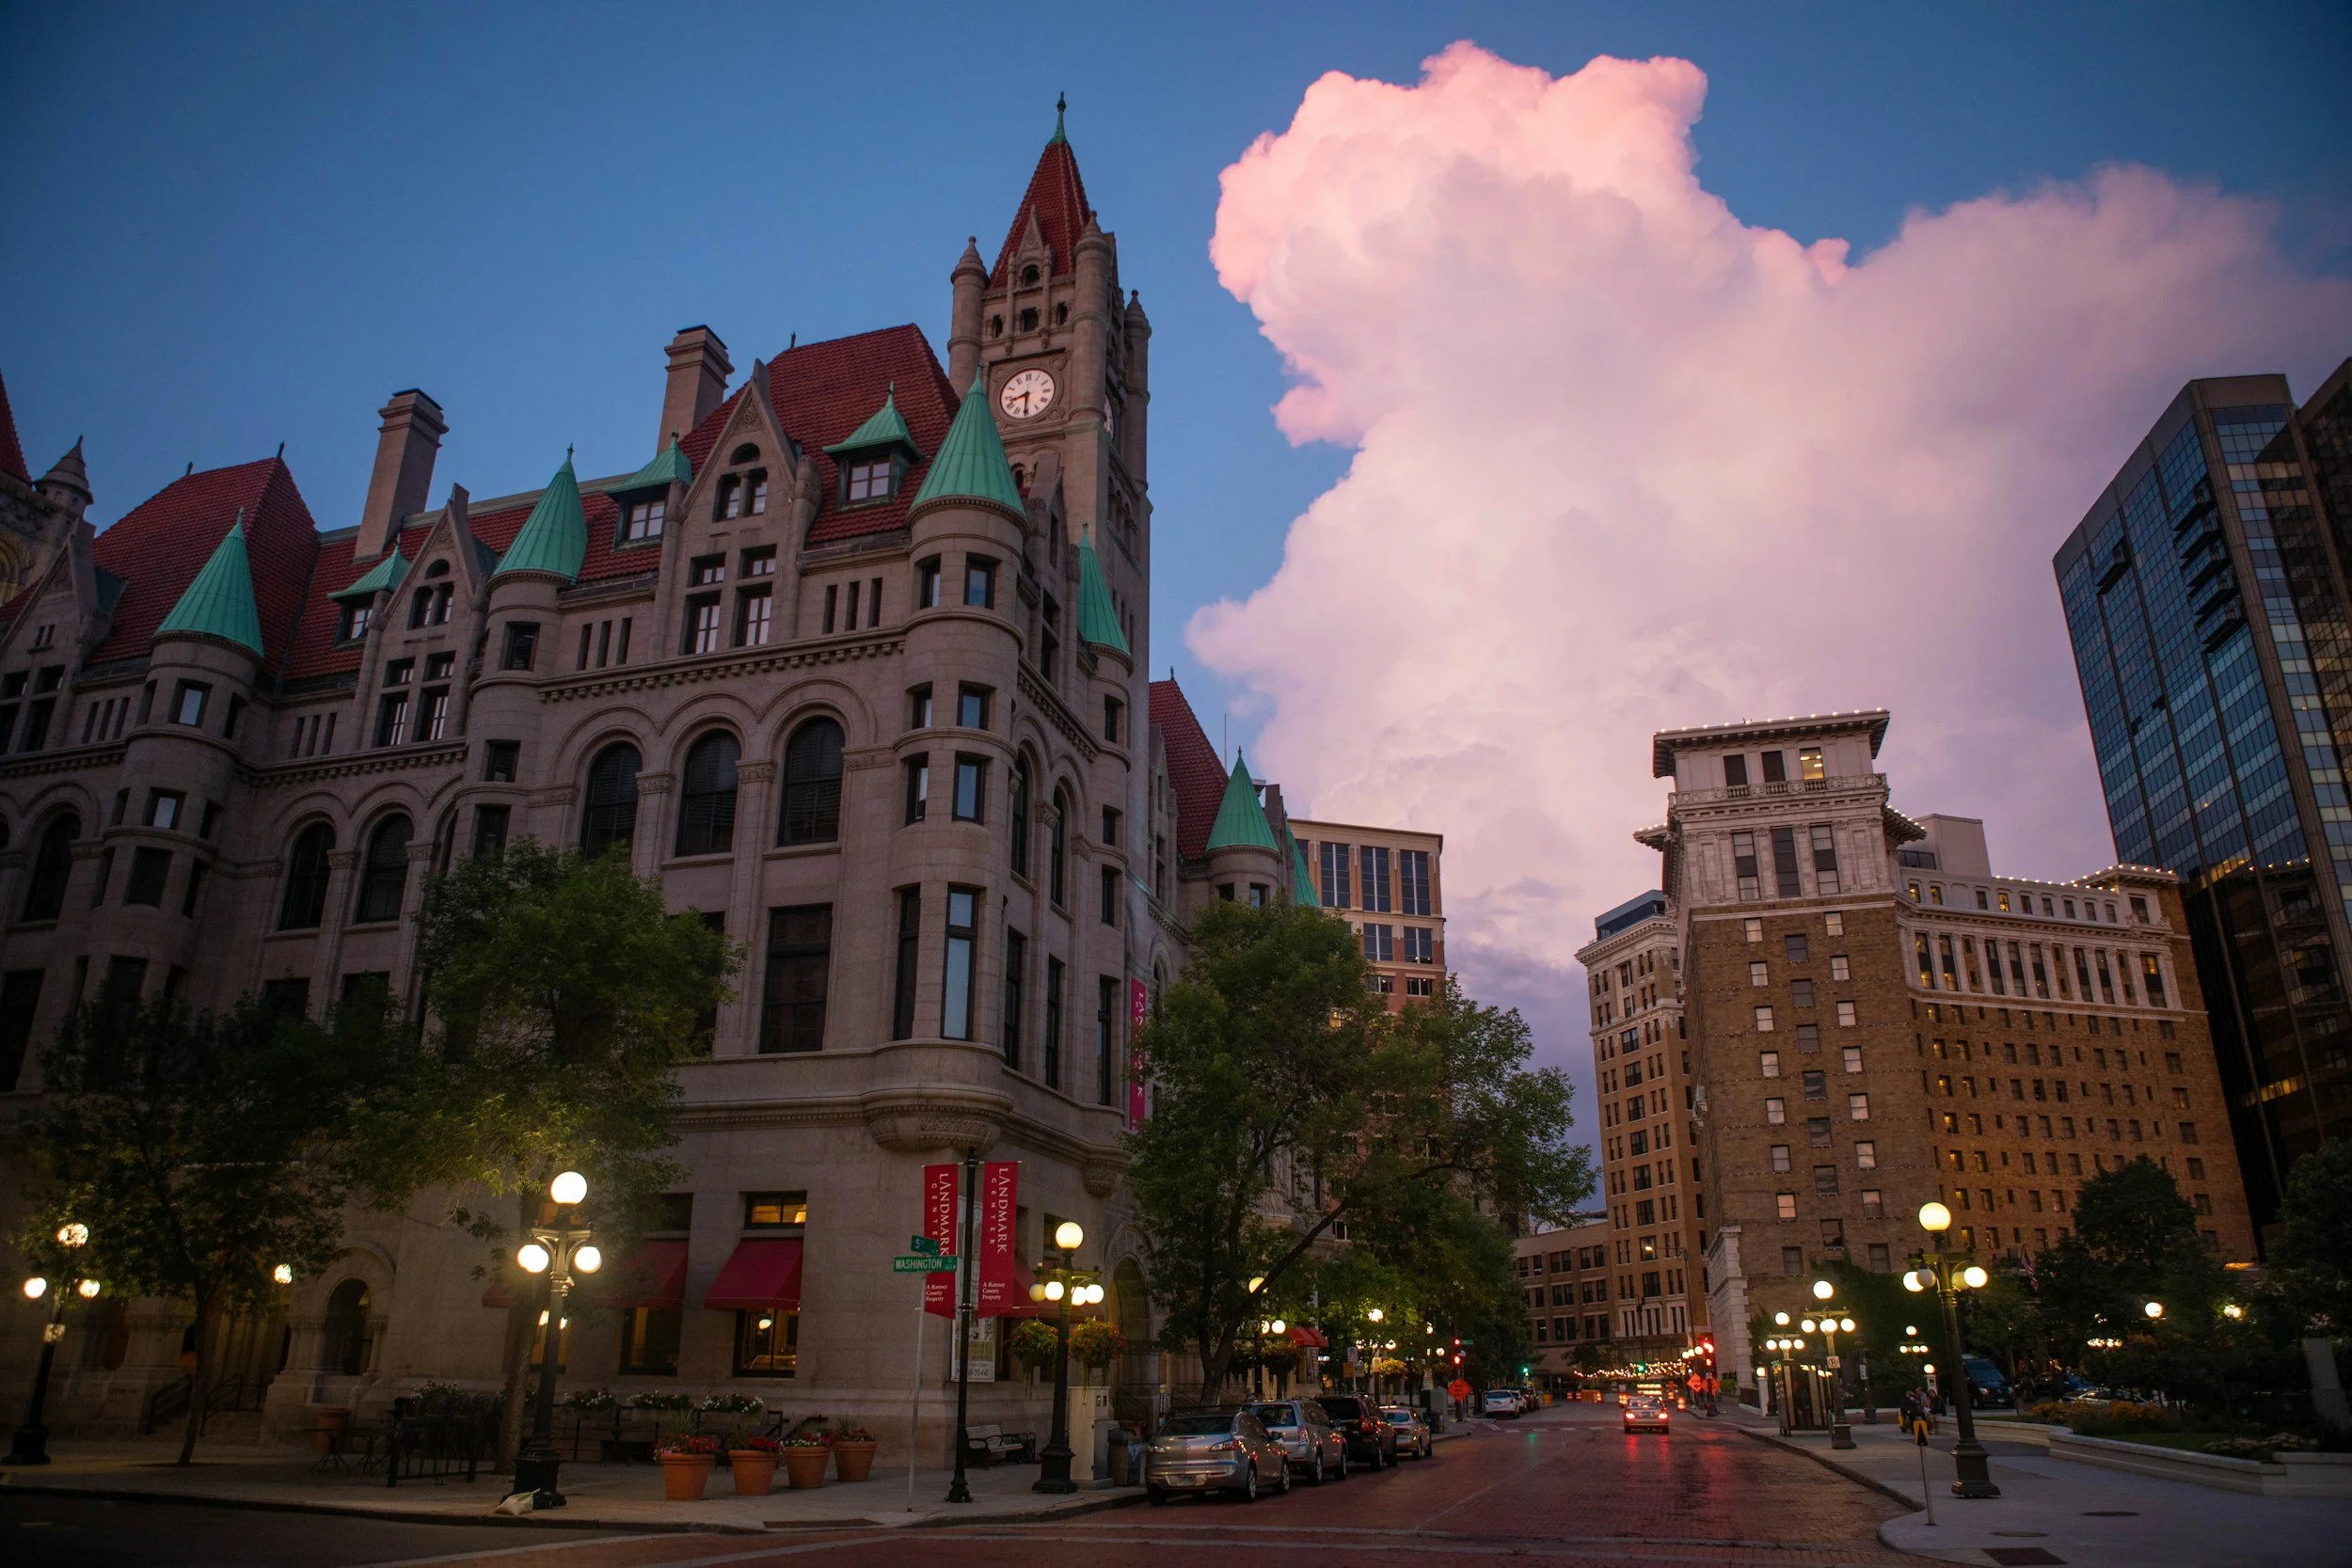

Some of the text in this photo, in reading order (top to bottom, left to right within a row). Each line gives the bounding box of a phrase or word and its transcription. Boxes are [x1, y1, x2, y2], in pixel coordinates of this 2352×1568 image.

[939, 1173, 951, 1256] LANDMARK
[998, 1167, 1009, 1254] LANDMARK
[895, 1259, 943, 1270] WASHINGTON
